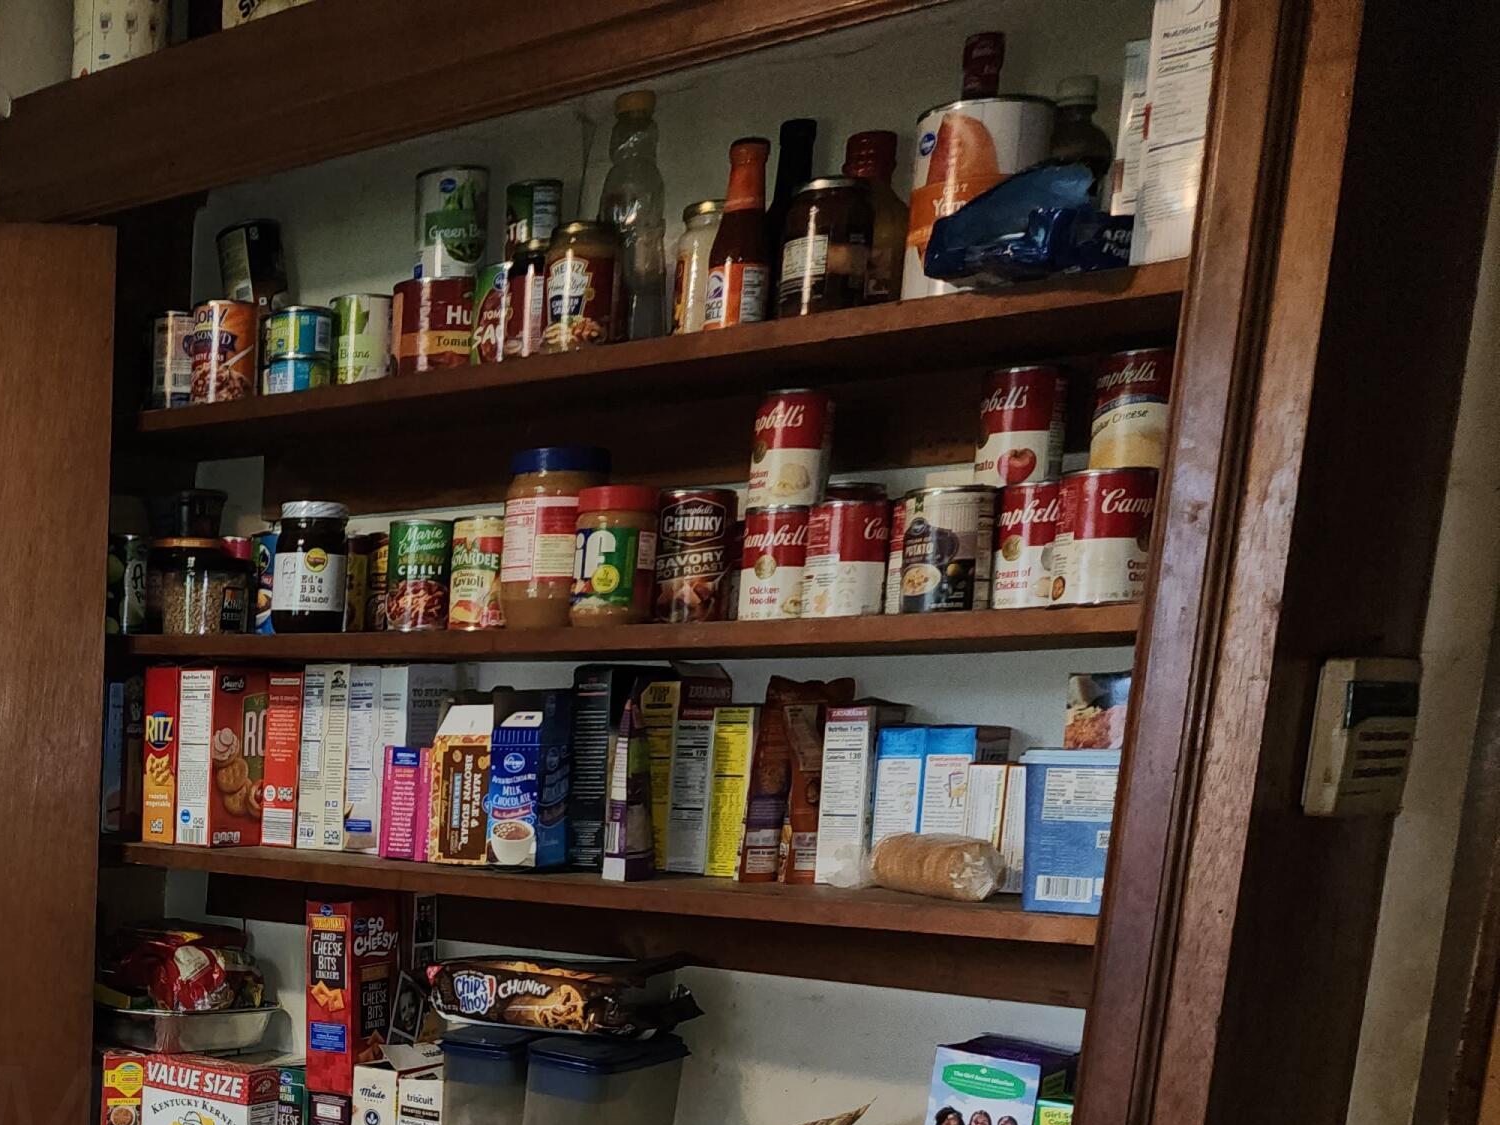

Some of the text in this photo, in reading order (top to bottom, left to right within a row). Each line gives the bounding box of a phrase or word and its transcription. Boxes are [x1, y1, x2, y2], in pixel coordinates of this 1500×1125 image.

[404, 525, 444, 542] Marie
[663, 515, 723, 535] CHUNKY
[657, 550, 724, 569] SAVORY
[397, 563, 443, 576] CHILI
[683, 562, 725, 576] ROAST
[301, 574, 324, 585] Ed's
[299, 594, 329, 605] Sauce
[145, 714, 175, 743] RITZ
[471, 773, 482, 817] MAPLE
[502, 785, 523, 796] MILK
[459, 754, 473, 851] BROWN SUGAR
[367, 916, 385, 935] SO
[313, 939, 344, 957] CHEESE
[354, 930, 399, 957] CHEESY!
[318, 956, 337, 971] BITS
[454, 976, 552, 999] Chips CHUNKY
[368, 1005, 384, 1020] BITS
[146, 1061, 244, 1099] VALUE SIZE
[359, 1087, 386, 1100] Made
[406, 1092, 434, 1106] triscuit
[150, 1098, 198, 1116] KENTUCKY
[1045, 1111, 1062, 1119] Girl
